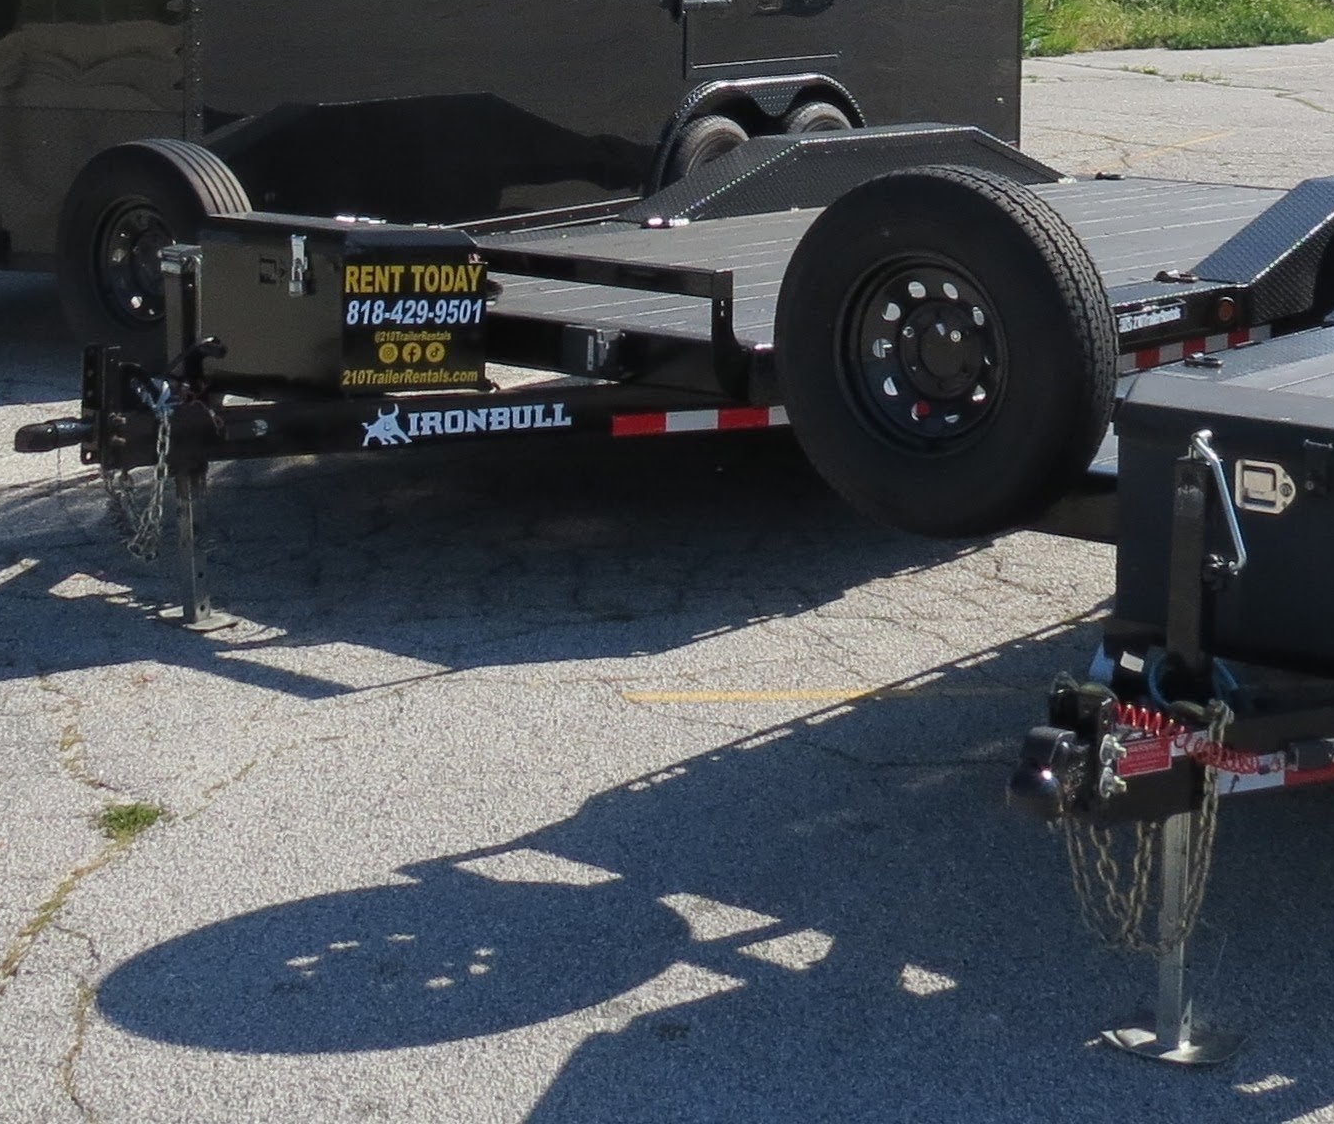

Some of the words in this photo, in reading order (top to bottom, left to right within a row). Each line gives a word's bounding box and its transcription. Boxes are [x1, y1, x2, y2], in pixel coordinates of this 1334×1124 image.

[345, 265, 404, 293] RENT
[411, 265, 483, 293] TODAY
[346, 299, 483, 325] 818-429-9501
[342, 369, 478, 385] 210TrailerRentals.com
[407, 403, 572, 437] IRONBULL
